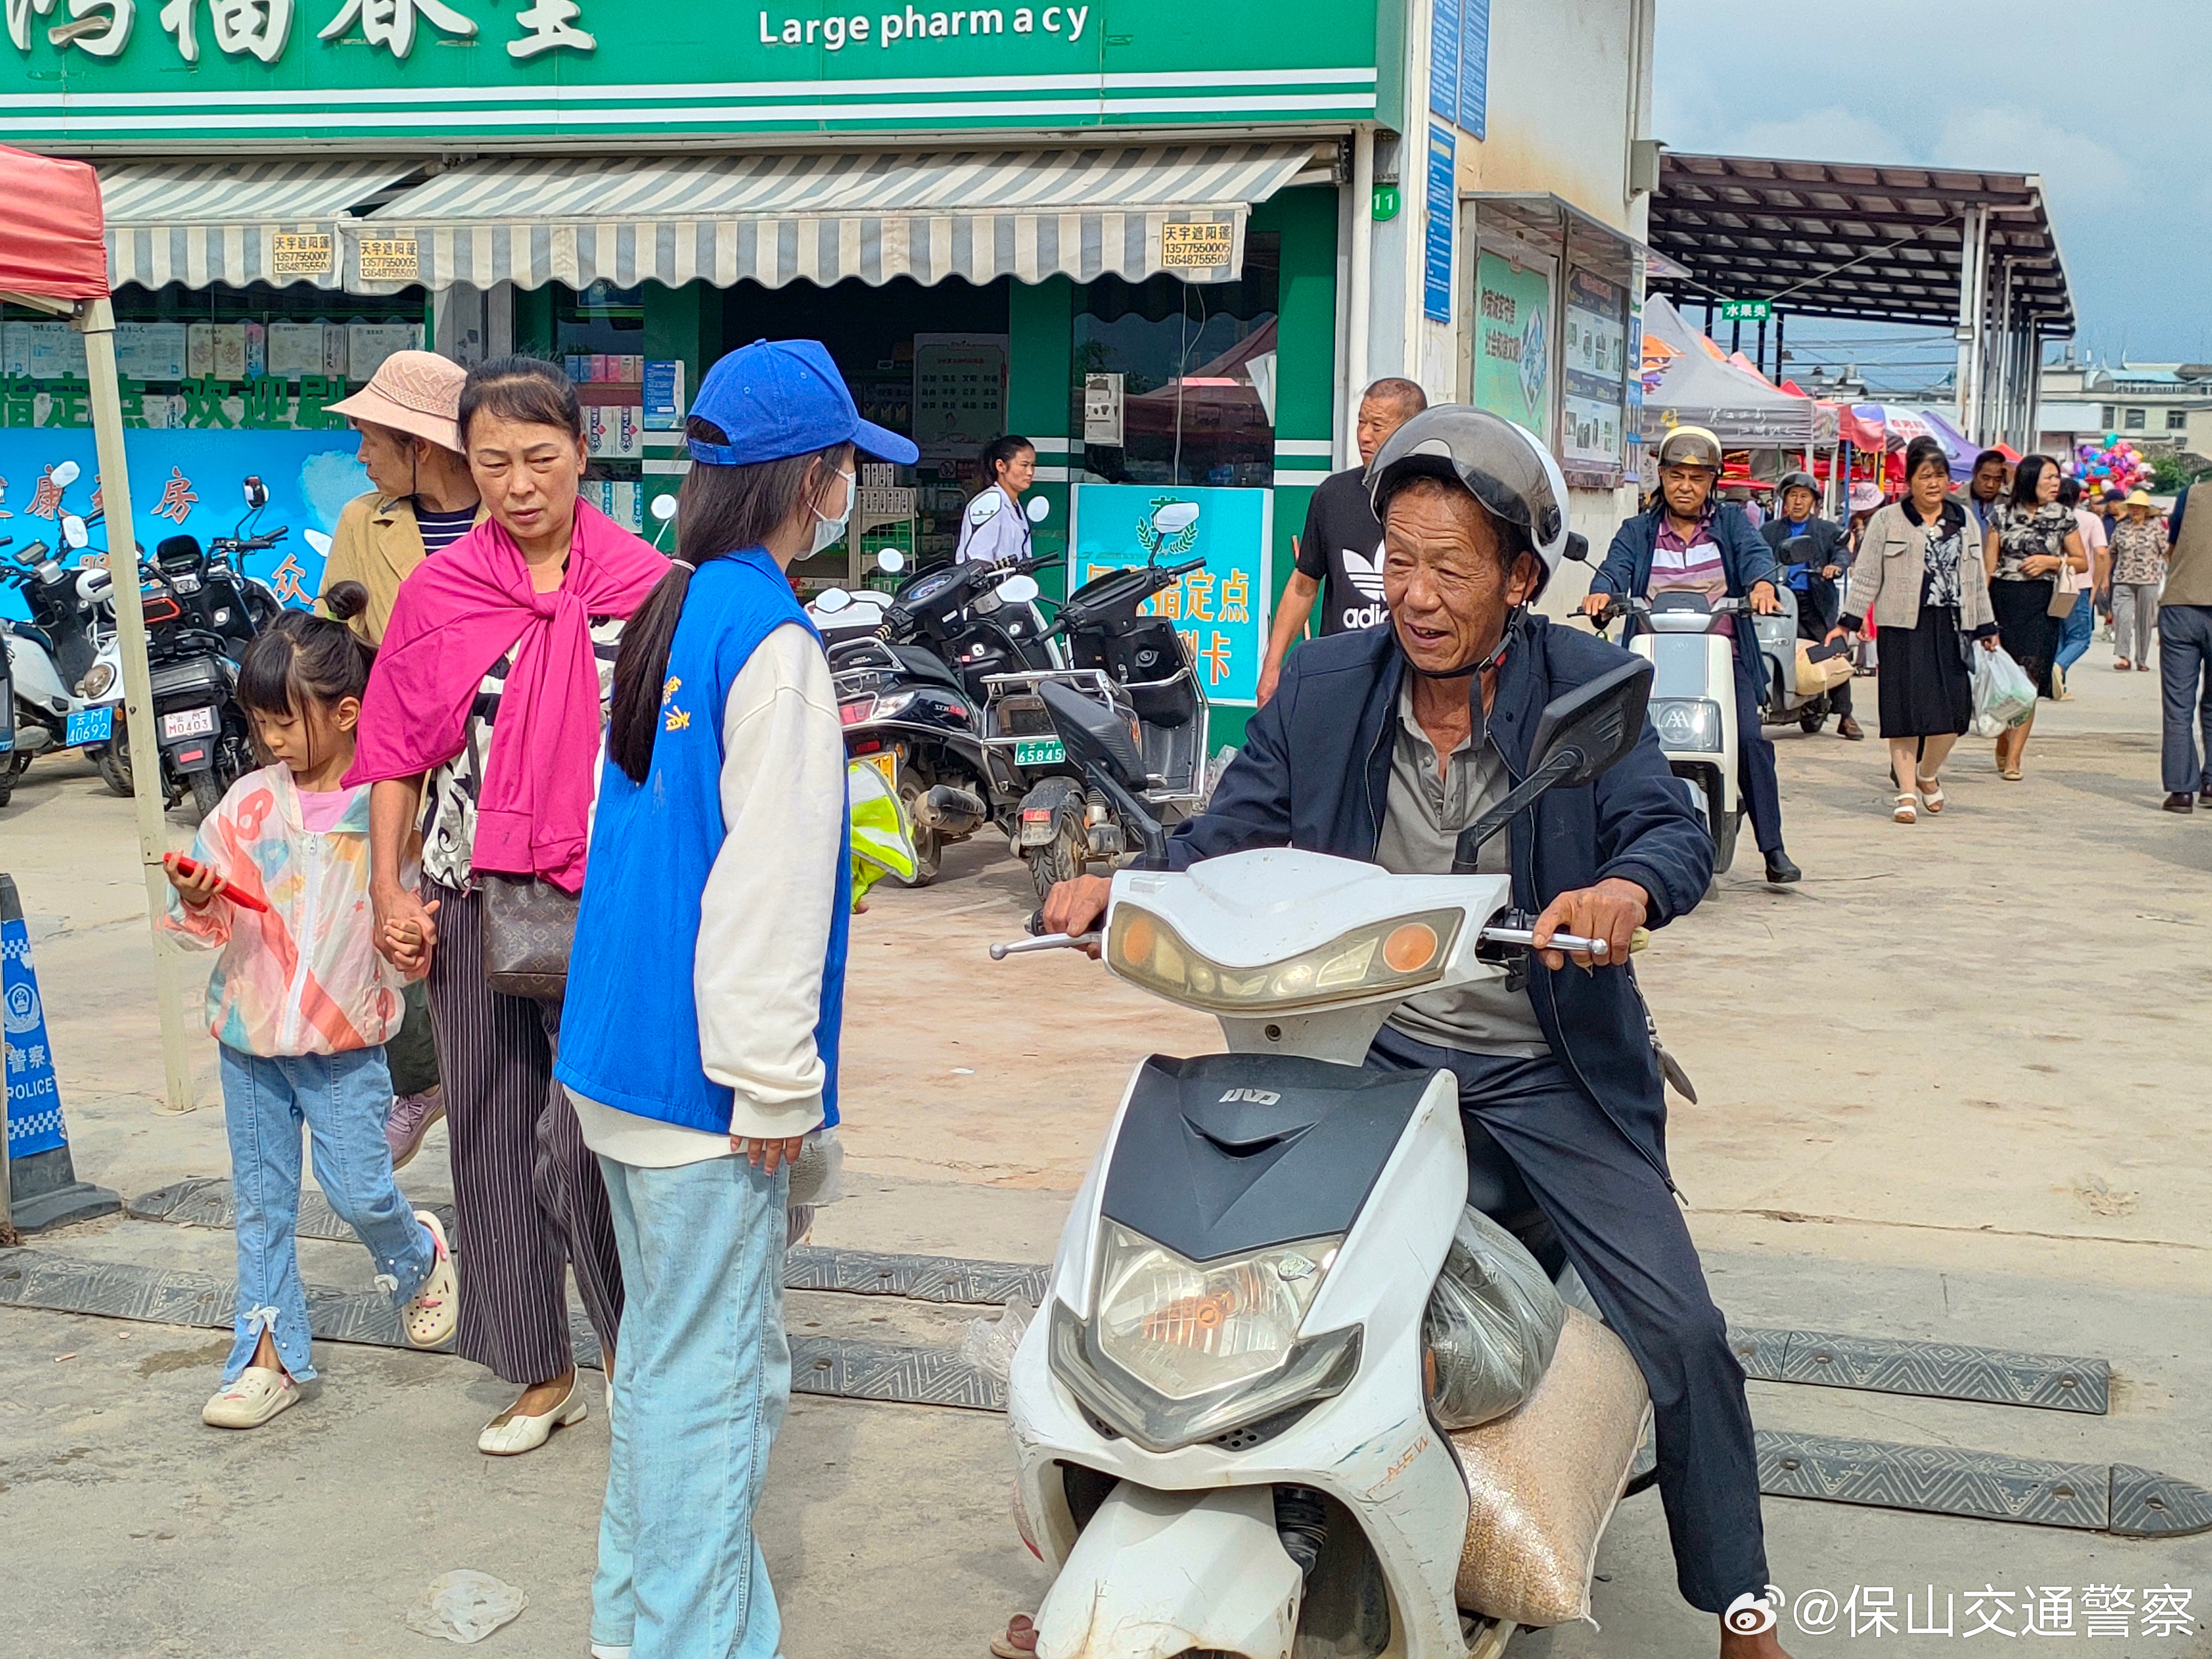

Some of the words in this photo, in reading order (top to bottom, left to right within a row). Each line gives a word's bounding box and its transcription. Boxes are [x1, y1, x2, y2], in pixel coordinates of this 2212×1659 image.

[759, 11, 870, 50] Large
[1165, 243, 1230, 253] 13577550005
[361, 257, 416, 267] 13577550005
[1164, 254, 1229, 265] 13648755500
[361, 268, 417, 277] 13648755500
[68, 723, 108, 742] 40692
[168, 719, 209, 735] M0403
[1018, 748, 1062, 763] 65845
[7, 1045, 45, 1074] 警察
[7, 1077, 54, 1100] POLICE
